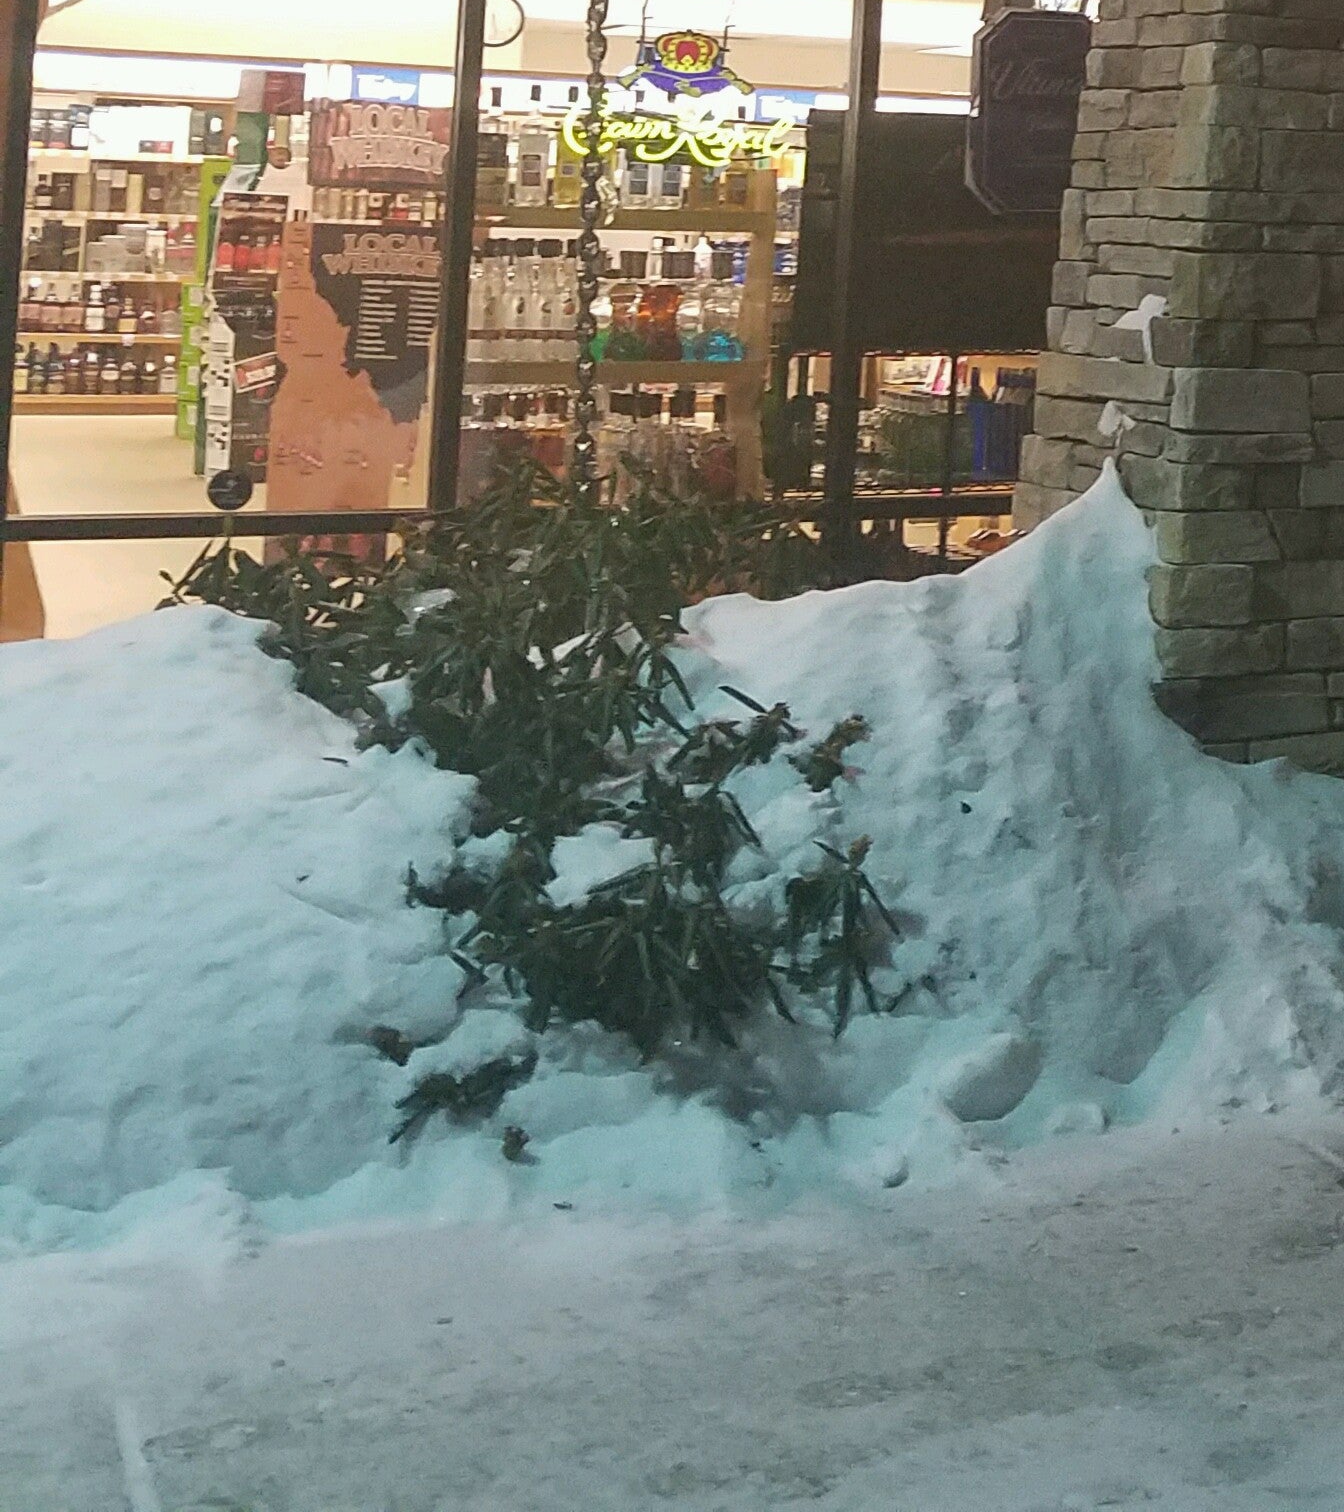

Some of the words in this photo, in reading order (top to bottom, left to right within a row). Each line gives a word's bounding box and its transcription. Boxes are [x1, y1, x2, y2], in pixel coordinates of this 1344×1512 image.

[342, 102, 434, 139] LOCAL
[327, 134, 450, 175] WHISKEY
[343, 233, 440, 256] LOCAL
